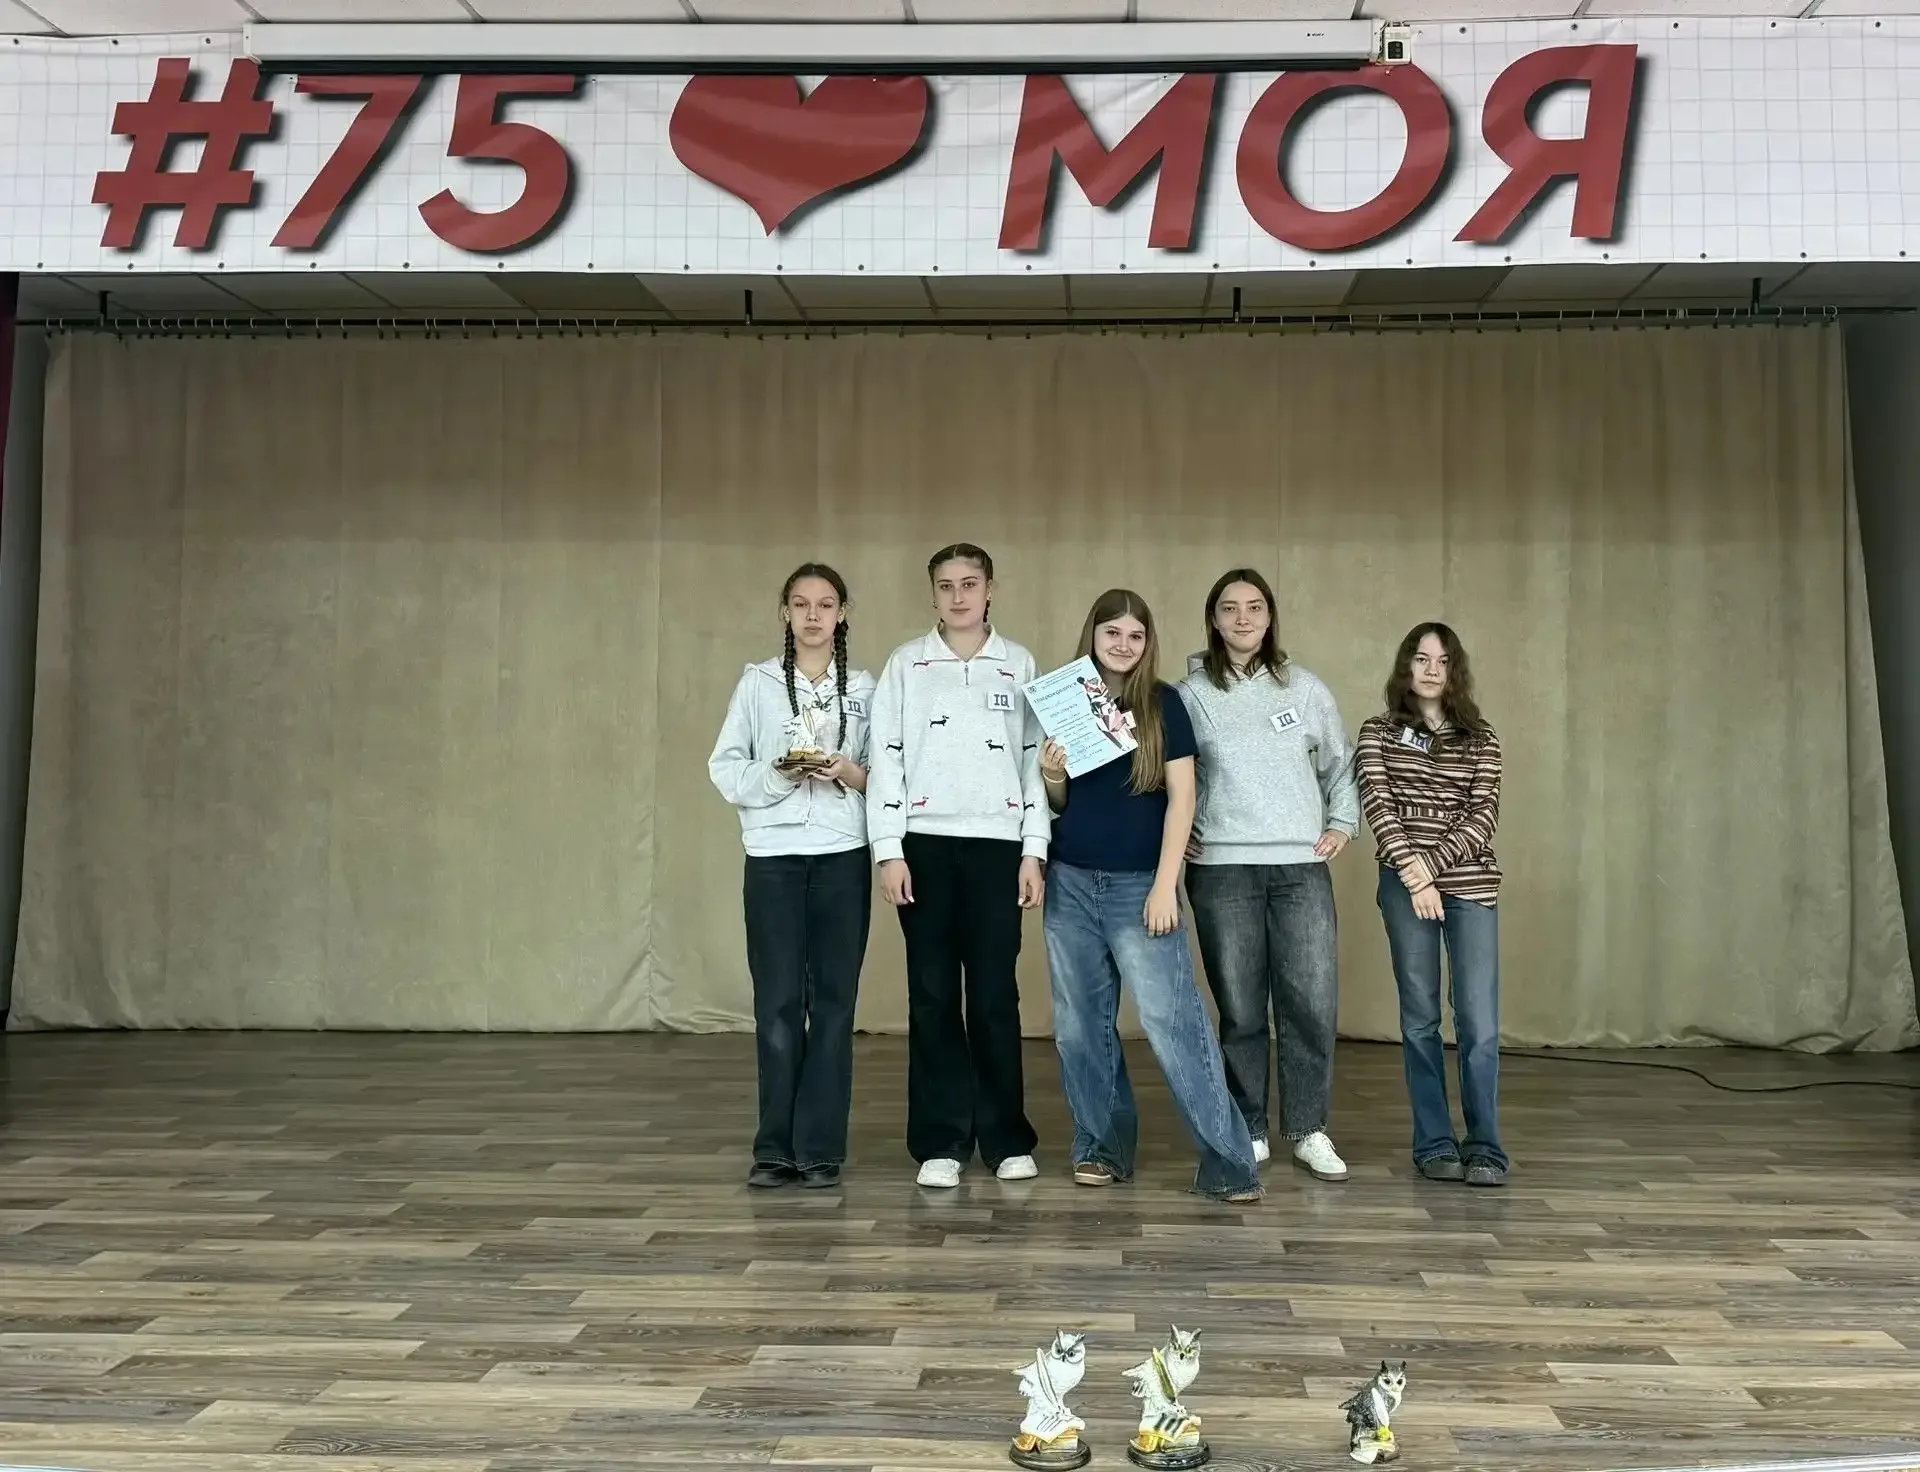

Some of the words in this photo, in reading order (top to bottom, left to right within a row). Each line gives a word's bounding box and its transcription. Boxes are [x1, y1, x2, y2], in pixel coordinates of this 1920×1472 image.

[91, 57, 577, 252] #75
[998, 44, 1638, 251] МОЯ
[847, 699, 863, 714] IQ
[993, 693, 1010, 708] IQ
[1276, 712, 1297, 727] IQ
